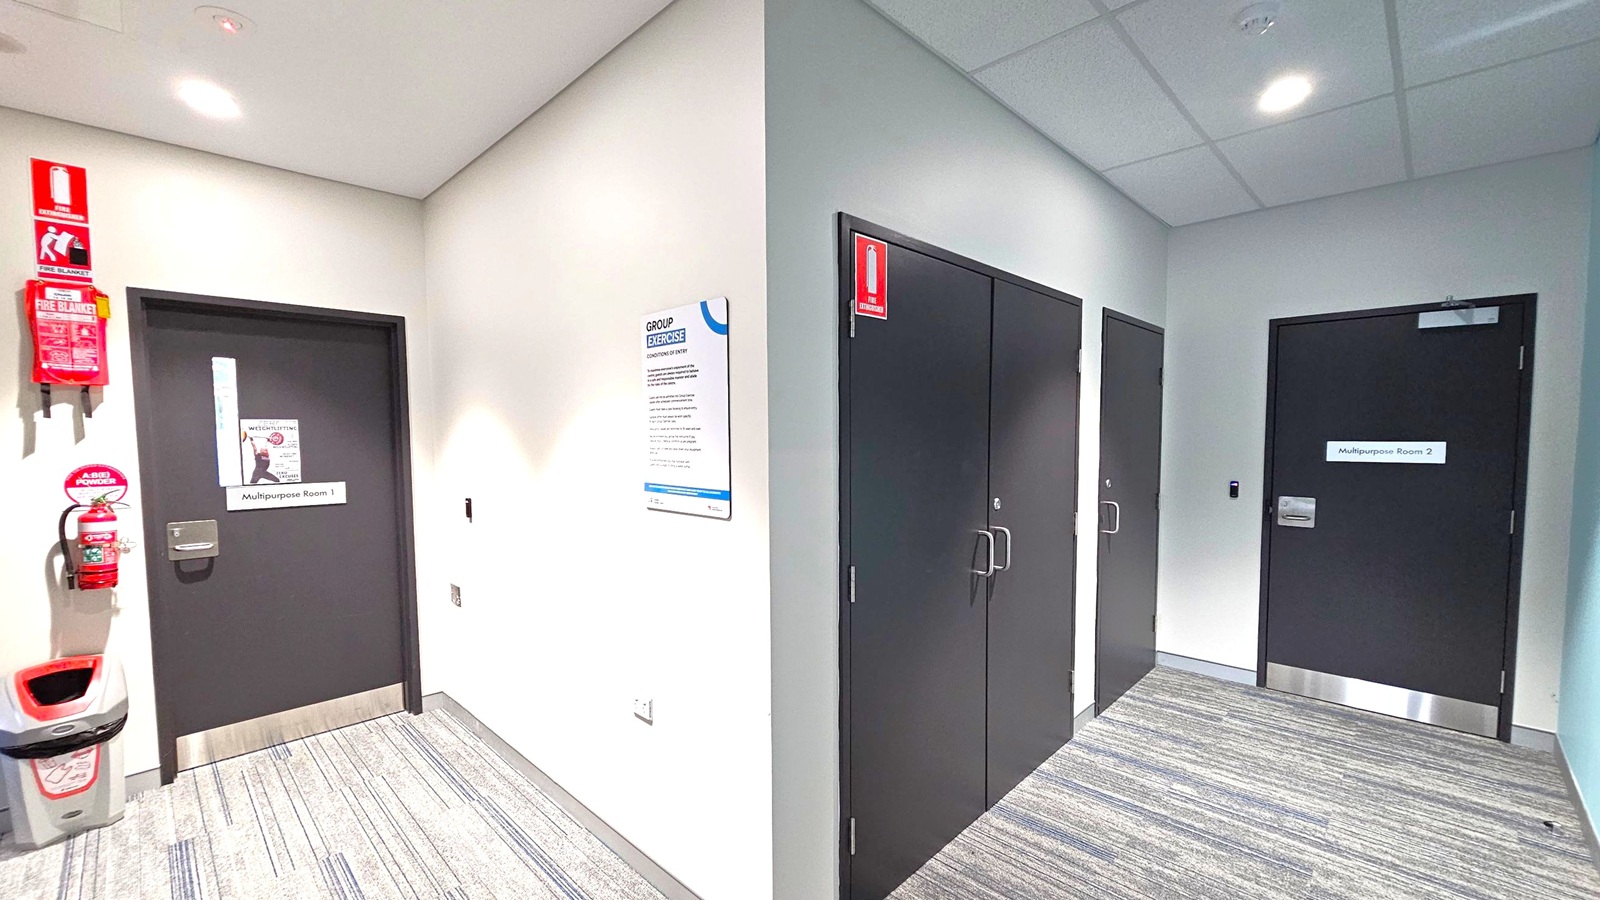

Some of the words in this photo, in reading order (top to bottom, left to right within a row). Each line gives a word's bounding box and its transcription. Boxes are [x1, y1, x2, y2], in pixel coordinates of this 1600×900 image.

[54, 204, 71, 212] FIRE
[57, 268, 89, 276] BLANKET
[35, 299, 56, 311] FIRE
[58, 301, 96, 315] BLANKET
[646, 316, 674, 332] GROUP
[648, 330, 684, 346] EXERCISE
[647, 350, 669, 359] CONDITIONS
[1338, 447, 1394, 456] Multipurpose
[242, 490, 301, 500] Multipurpose
